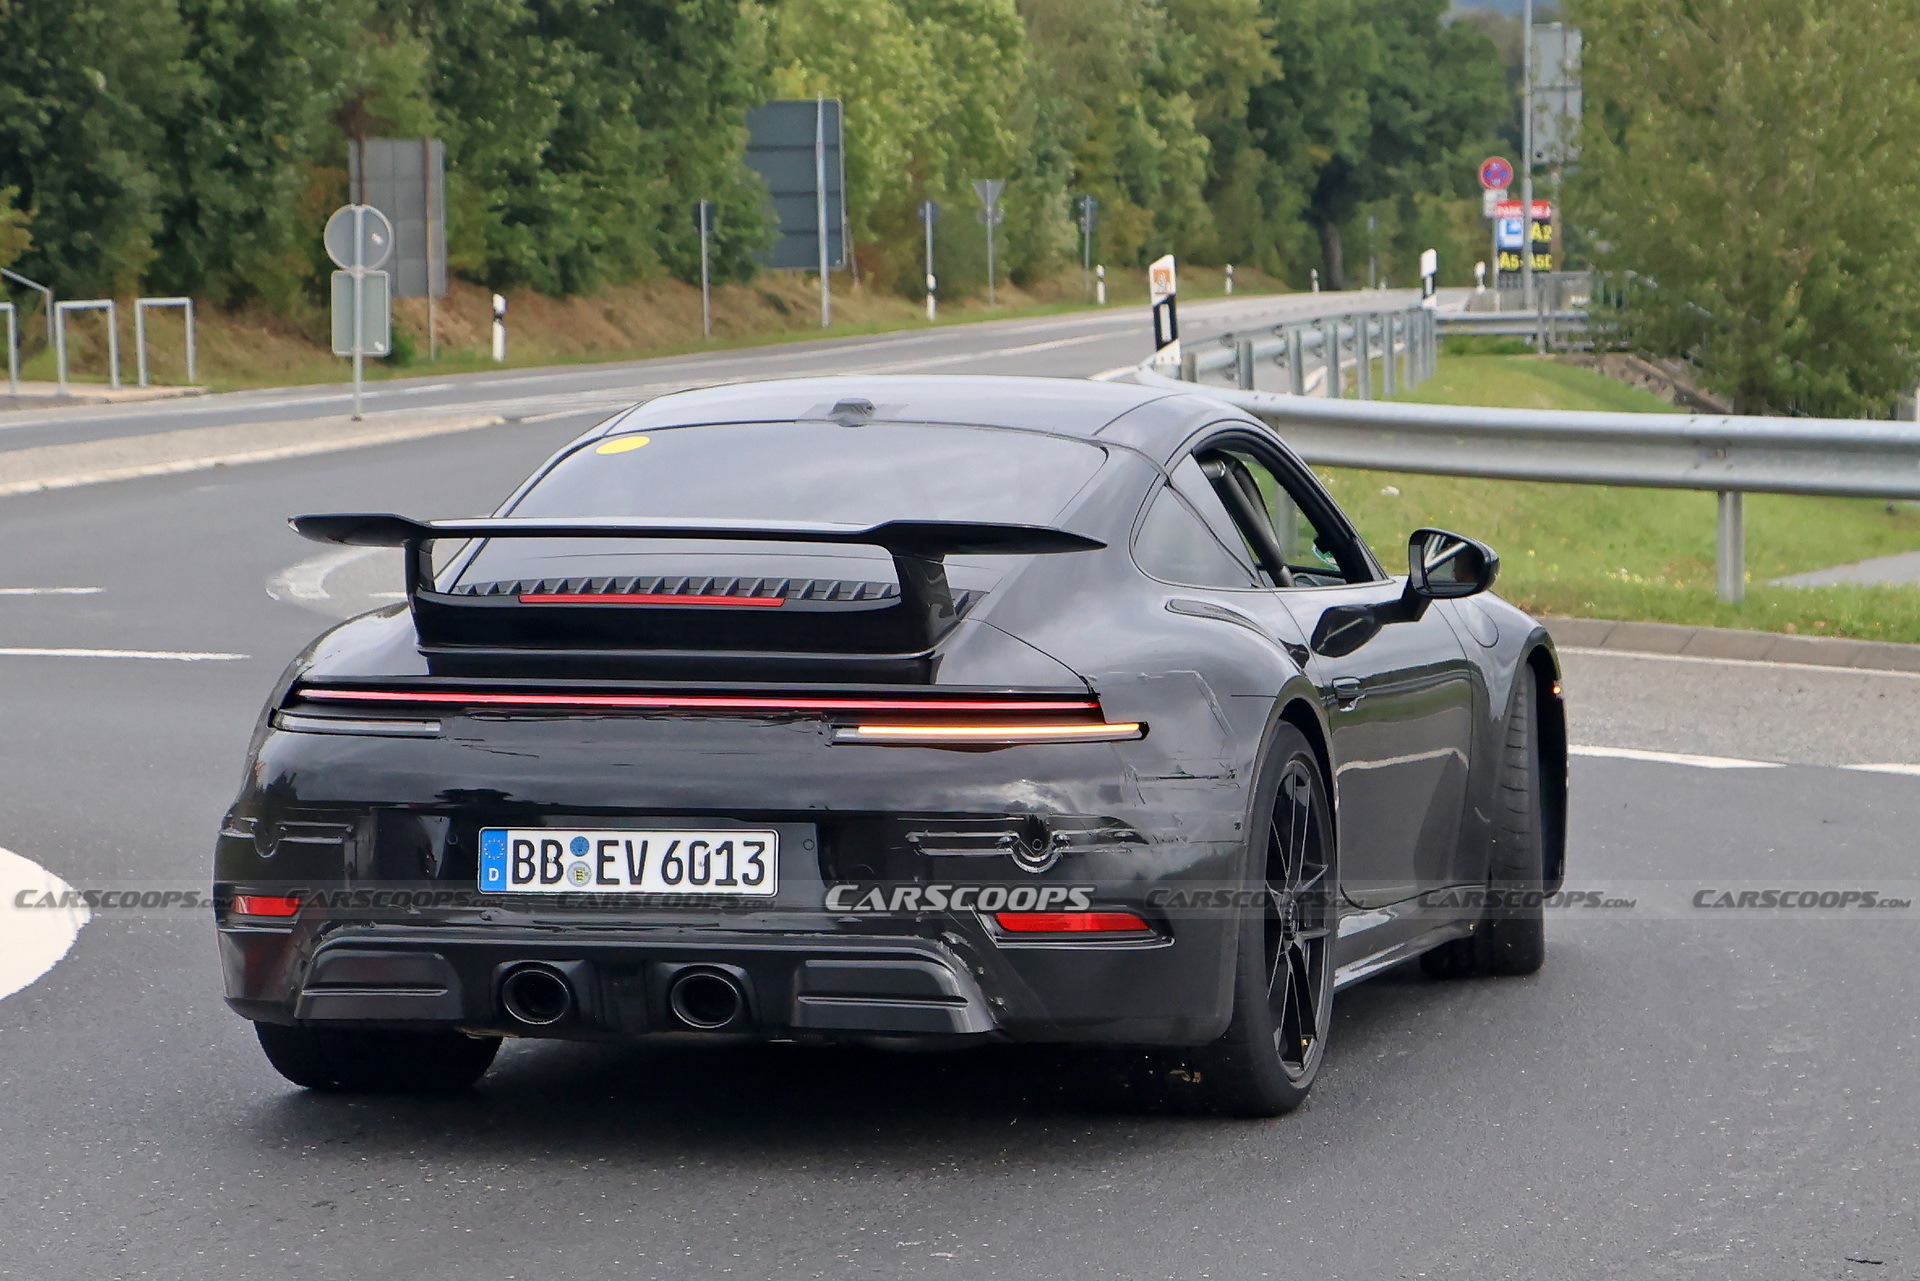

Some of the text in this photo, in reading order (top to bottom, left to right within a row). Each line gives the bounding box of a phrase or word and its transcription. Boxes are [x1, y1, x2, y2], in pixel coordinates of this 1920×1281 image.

[489, 868, 499, 881] D
[512, 840, 766, 887] BB EV 6013
